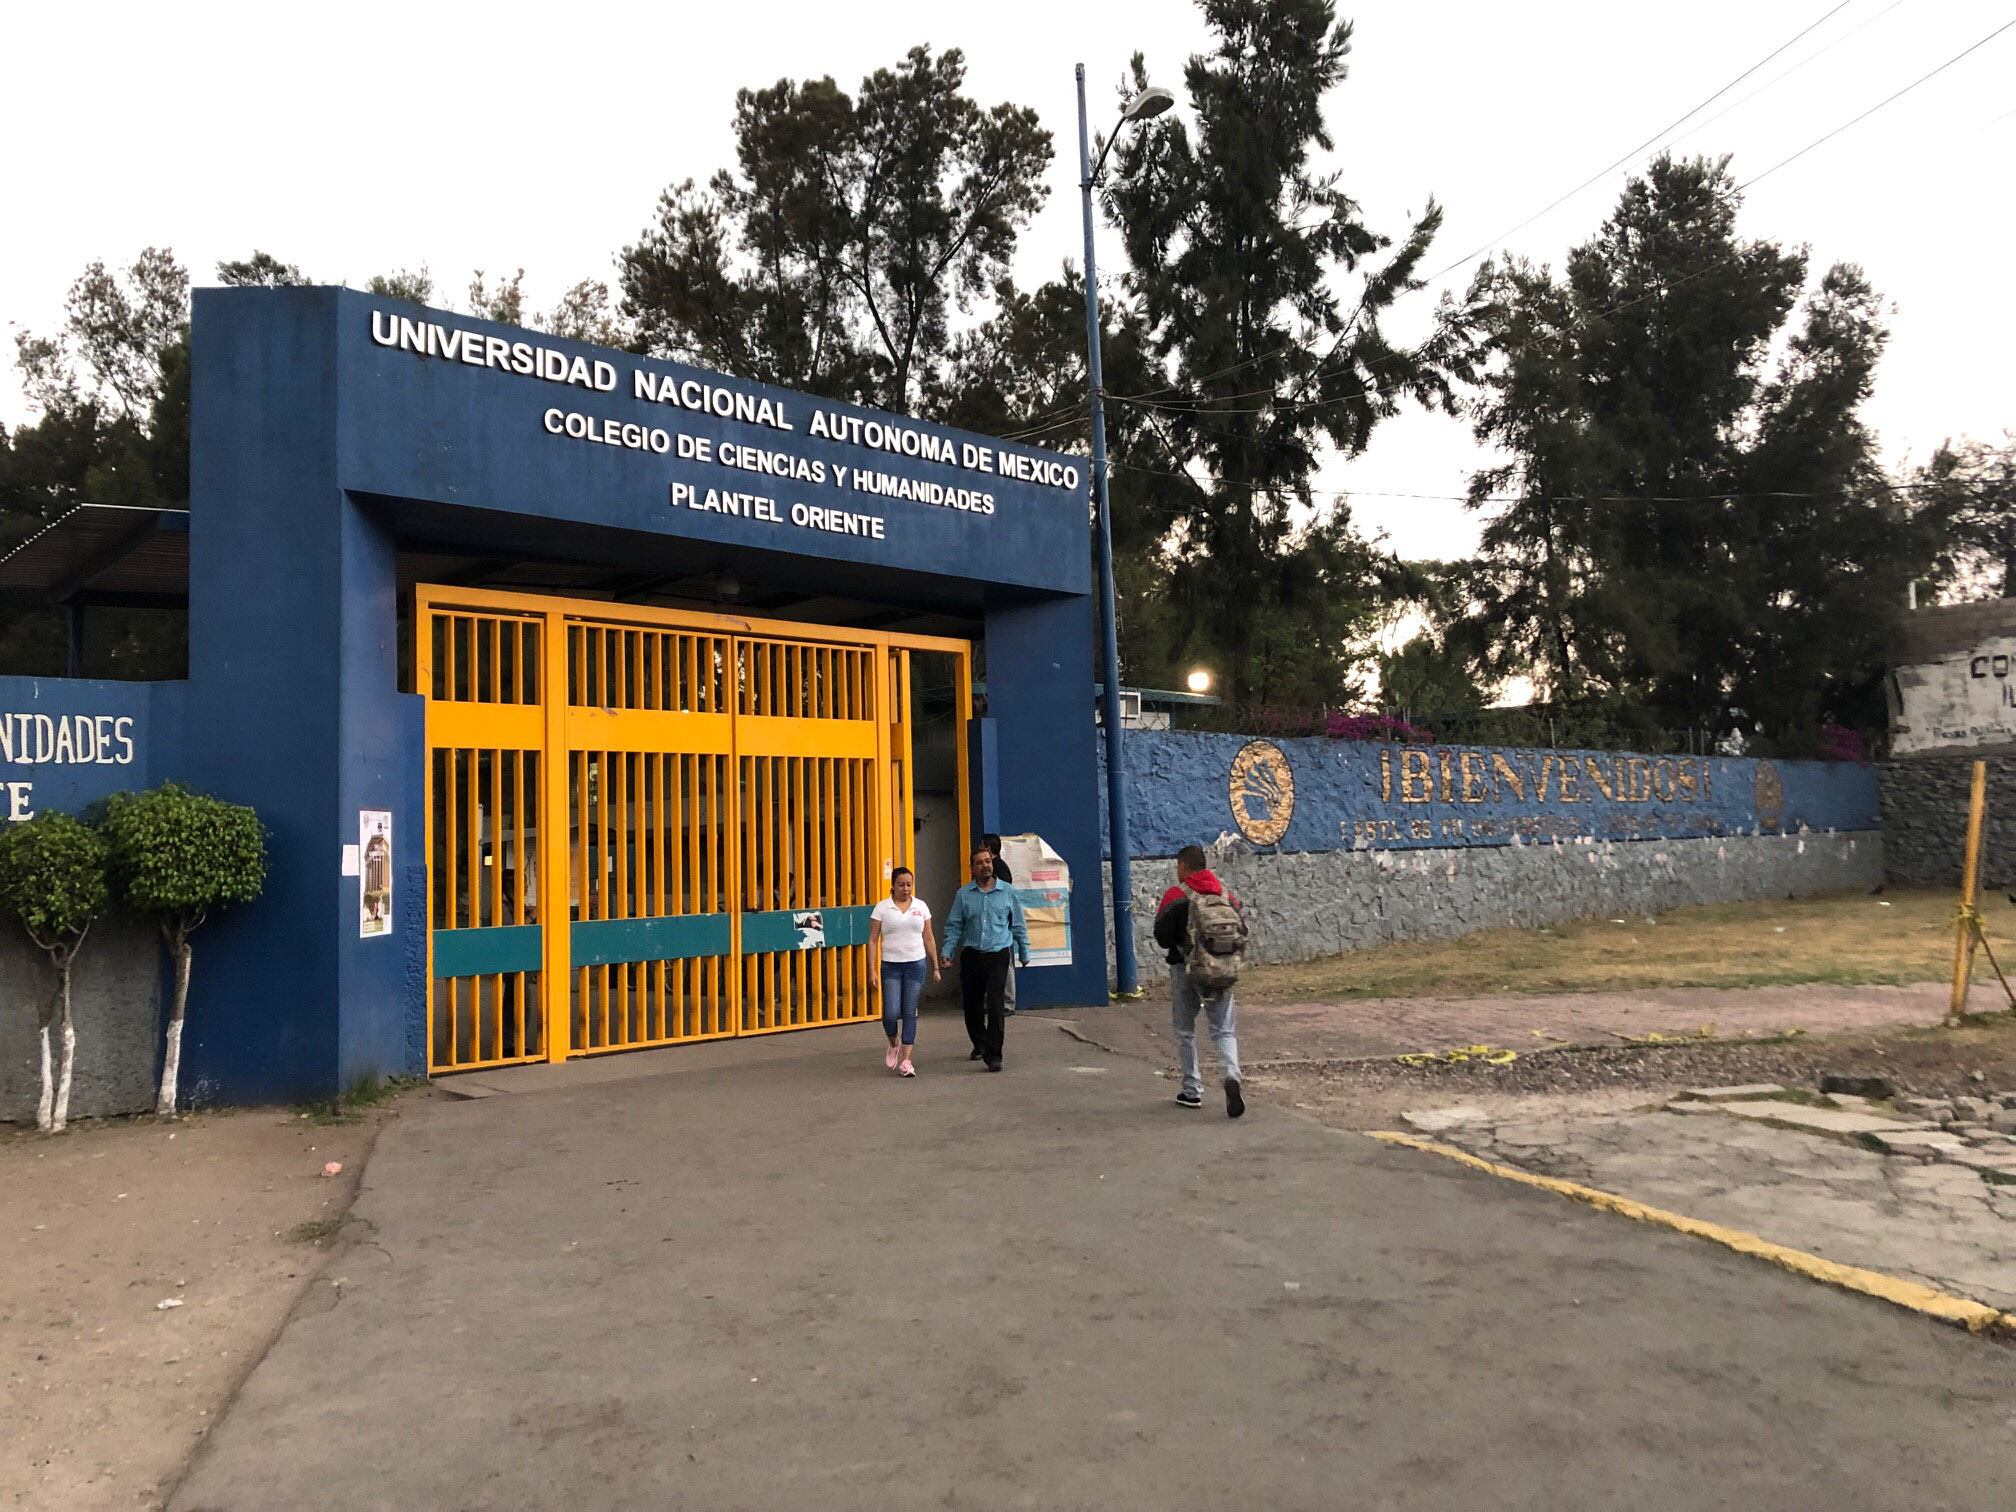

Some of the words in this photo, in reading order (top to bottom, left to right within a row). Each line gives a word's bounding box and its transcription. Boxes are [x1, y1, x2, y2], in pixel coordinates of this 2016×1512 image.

[372, 310, 617, 392] UNIVERSIDAD
[634, 369, 793, 431] NACIONAL
[809, 409, 957, 466] AUTONOMA
[962, 442, 994, 473] DE
[998, 451, 1079, 490] MEXICO
[544, 408, 670, 454] COLEGIO
[677, 433, 712, 463] DE
[718, 441, 826, 484] CIENCIAS
[831, 463, 848, 488] Y
[853, 468, 995, 515] HUMANIDADES
[671, 481, 784, 523] PLANTEL
[791, 502, 885, 540] ORIENTE
